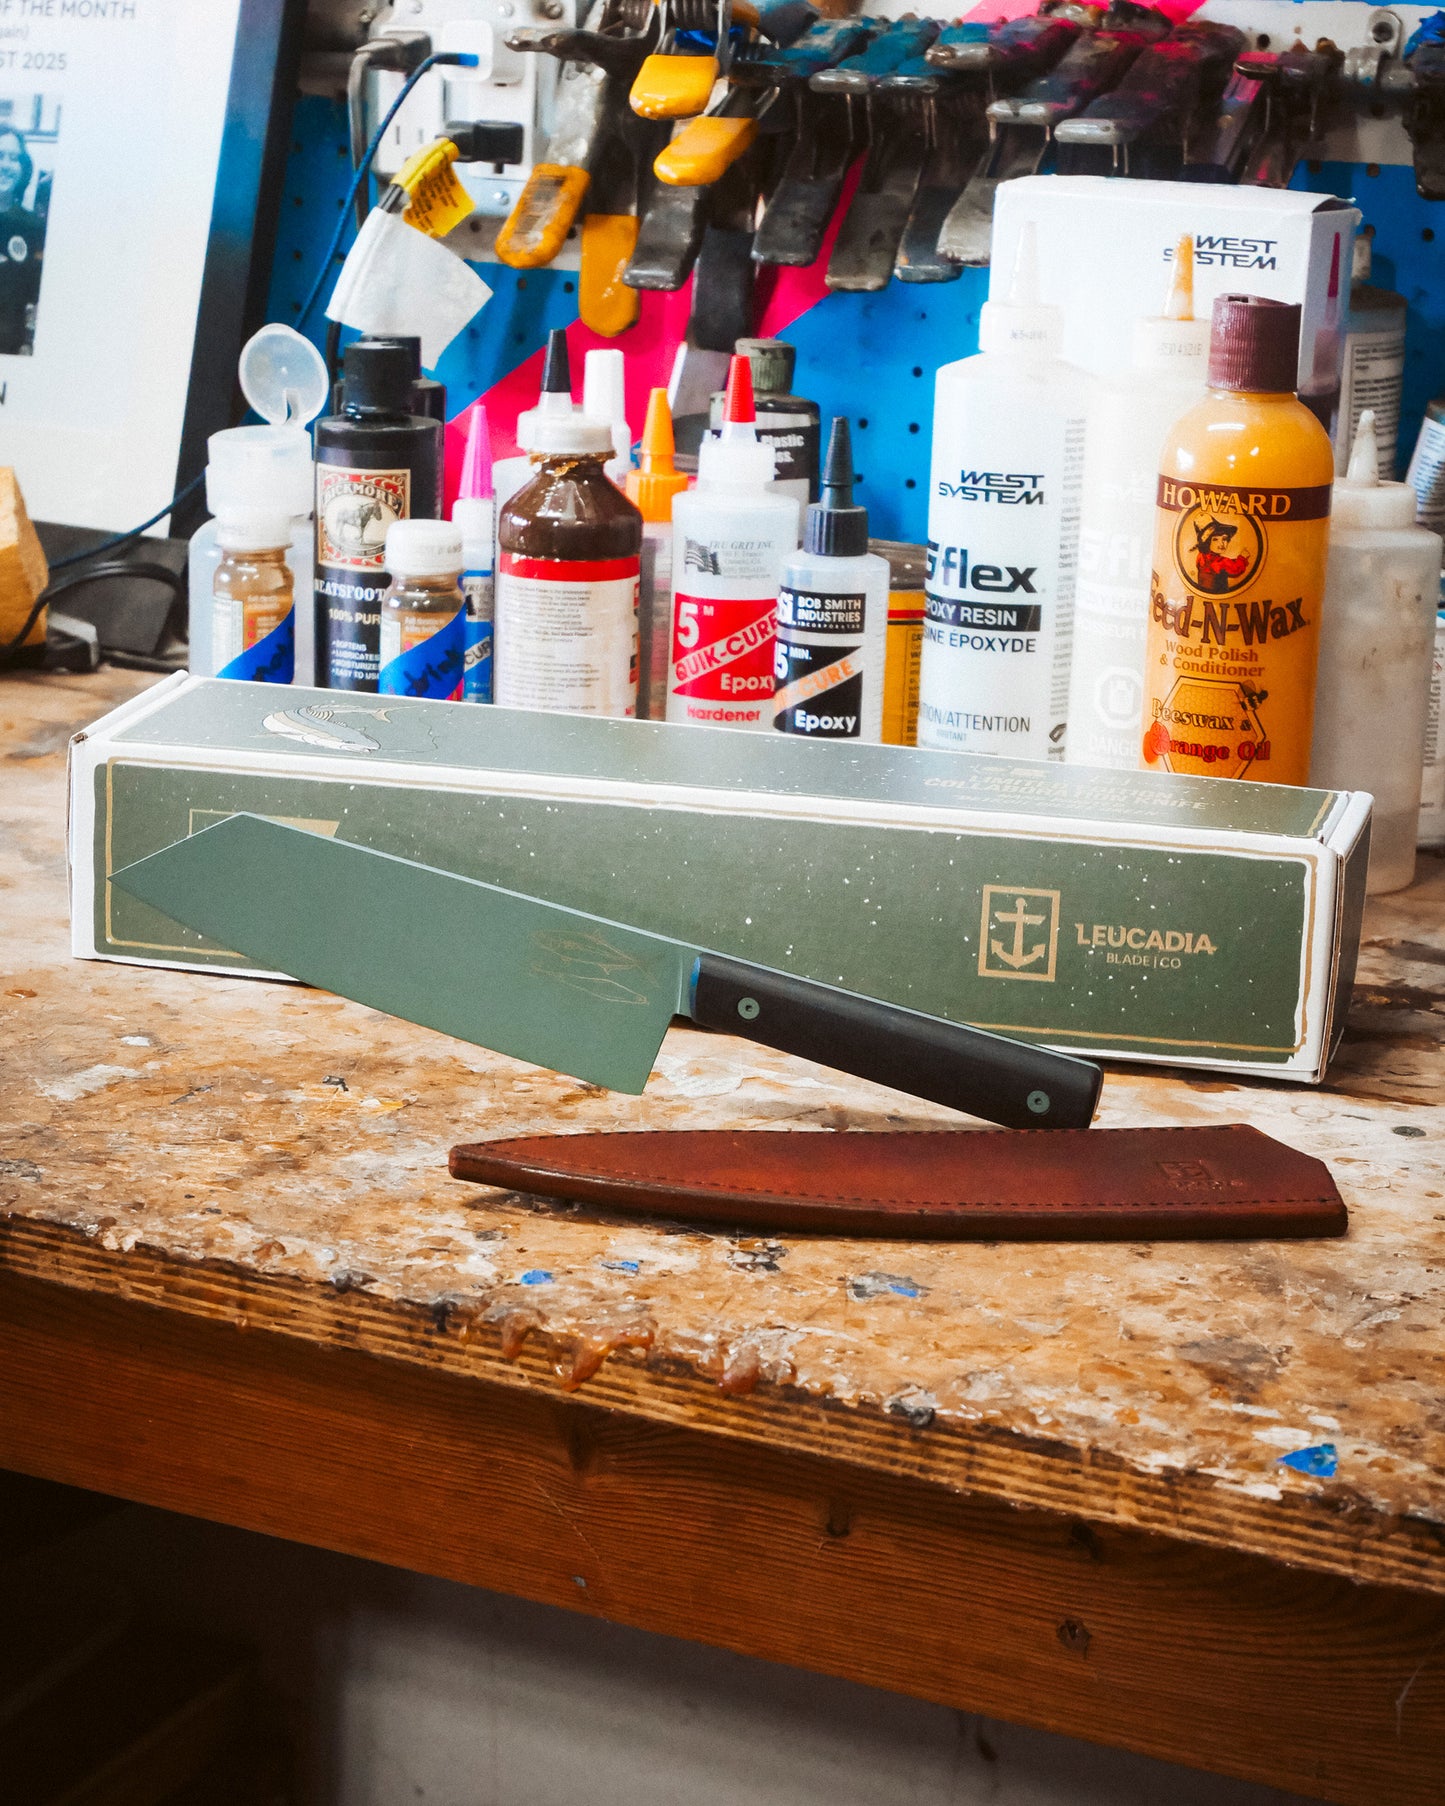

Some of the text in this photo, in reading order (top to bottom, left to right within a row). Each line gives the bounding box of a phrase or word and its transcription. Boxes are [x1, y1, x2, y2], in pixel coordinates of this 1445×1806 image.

[0, 0, 137, 18] F THE MONTH
[22, 52, 68, 70] 2025
[1195, 235, 1278, 254] WEST
[1162, 247, 1277, 270] SSTEM
[960, 469, 1045, 489] WEST
[938, 481, 1045, 505] SYSTEM
[1162, 481, 1292, 517] HOWARD
[797, 595, 821, 609] BOB
[824, 598, 862, 611] SMITH
[926, 597, 1018, 627] POXY RESIN
[328, 608, 381, 625] 100% PUR
[677, 601, 700, 648] 5
[797, 608, 862, 623] INDUSTRIES
[949, 628, 1037, 653] ÉPOXYDE
[1165, 638, 1259, 663] Wood Polish
[773, 640, 789, 680] 5
[1159, 653, 1265, 677] & Conditioner
[794, 708, 857, 734] Epoxy
[1151, 697, 1235, 731] Beeswax
[1236, 740, 1272, 761] Oil
[1074, 922, 1218, 956] LEUCADIA
